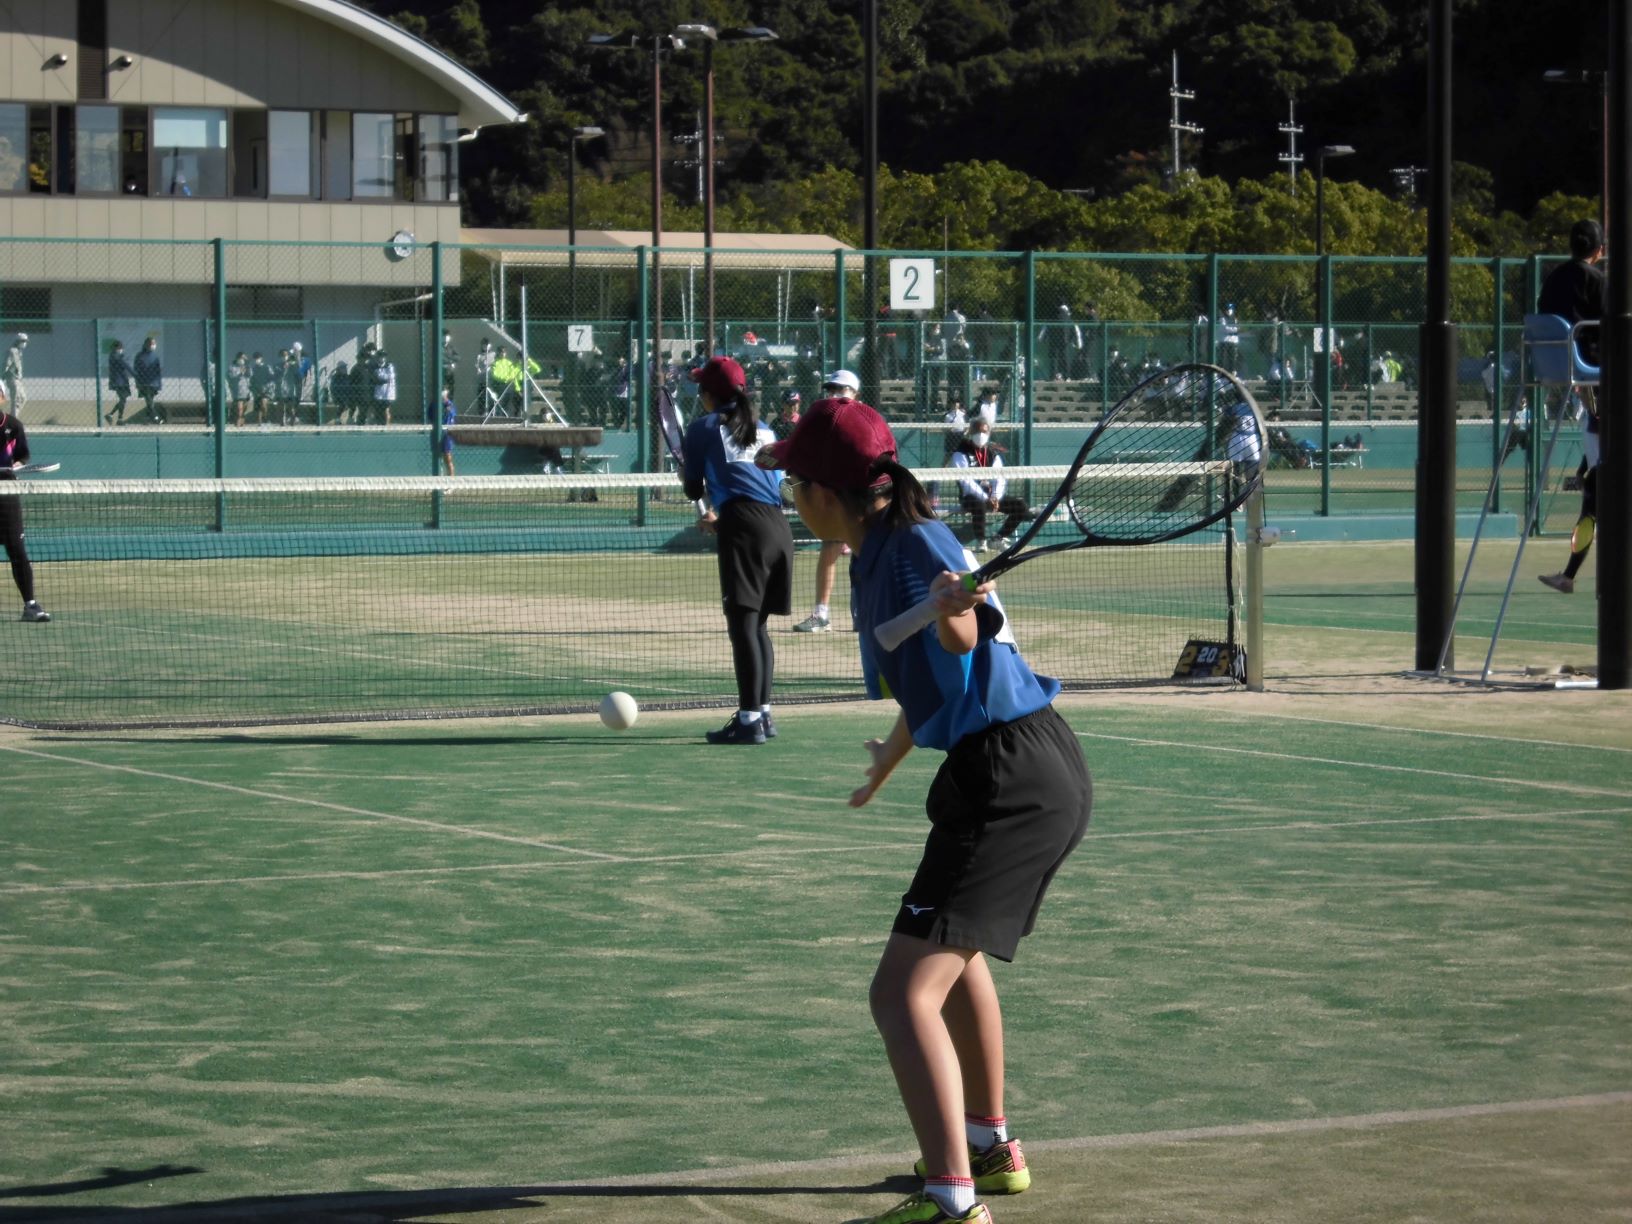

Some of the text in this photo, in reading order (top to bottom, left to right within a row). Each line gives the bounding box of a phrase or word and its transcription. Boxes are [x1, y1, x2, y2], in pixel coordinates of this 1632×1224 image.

[903, 265, 920, 300] 2
[574, 328, 586, 346] 7
[1175, 645, 1197, 673] 2
[1196, 646, 1218, 664] 20
